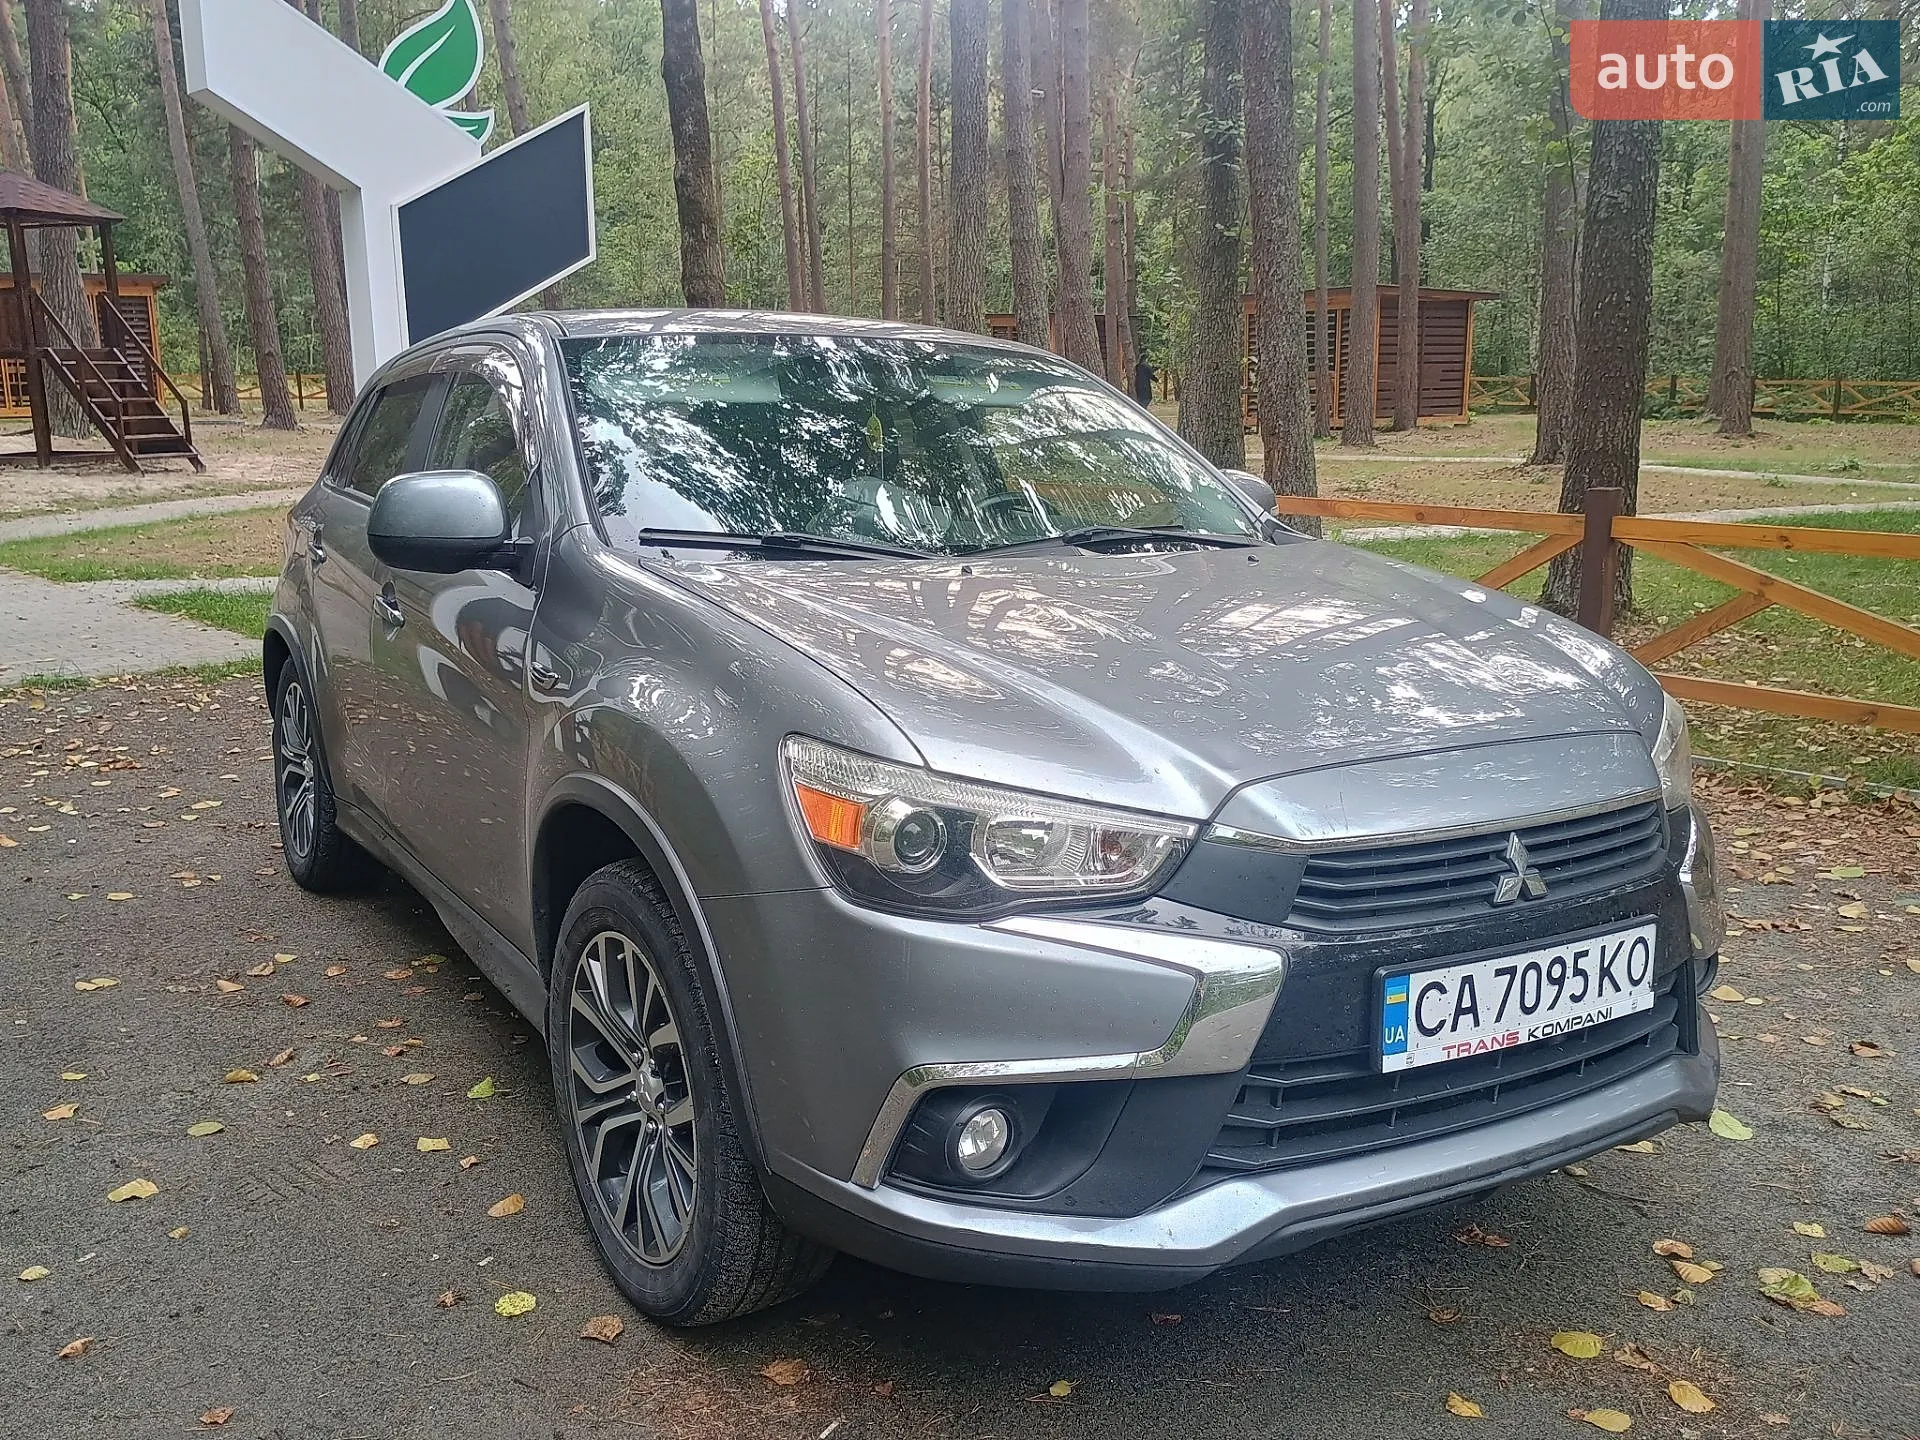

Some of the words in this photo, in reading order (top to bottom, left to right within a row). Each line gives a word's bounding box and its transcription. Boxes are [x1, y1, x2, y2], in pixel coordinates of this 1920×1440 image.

[1414, 974, 1480, 1037] CA
[1493, 949, 1590, 1024] 7095
[1597, 935, 1650, 997] KO
[1384, 1026, 1405, 1045] UA
[1442, 1030, 1520, 1060] TRANS
[1527, 1006, 1613, 1041] KOMPANI
